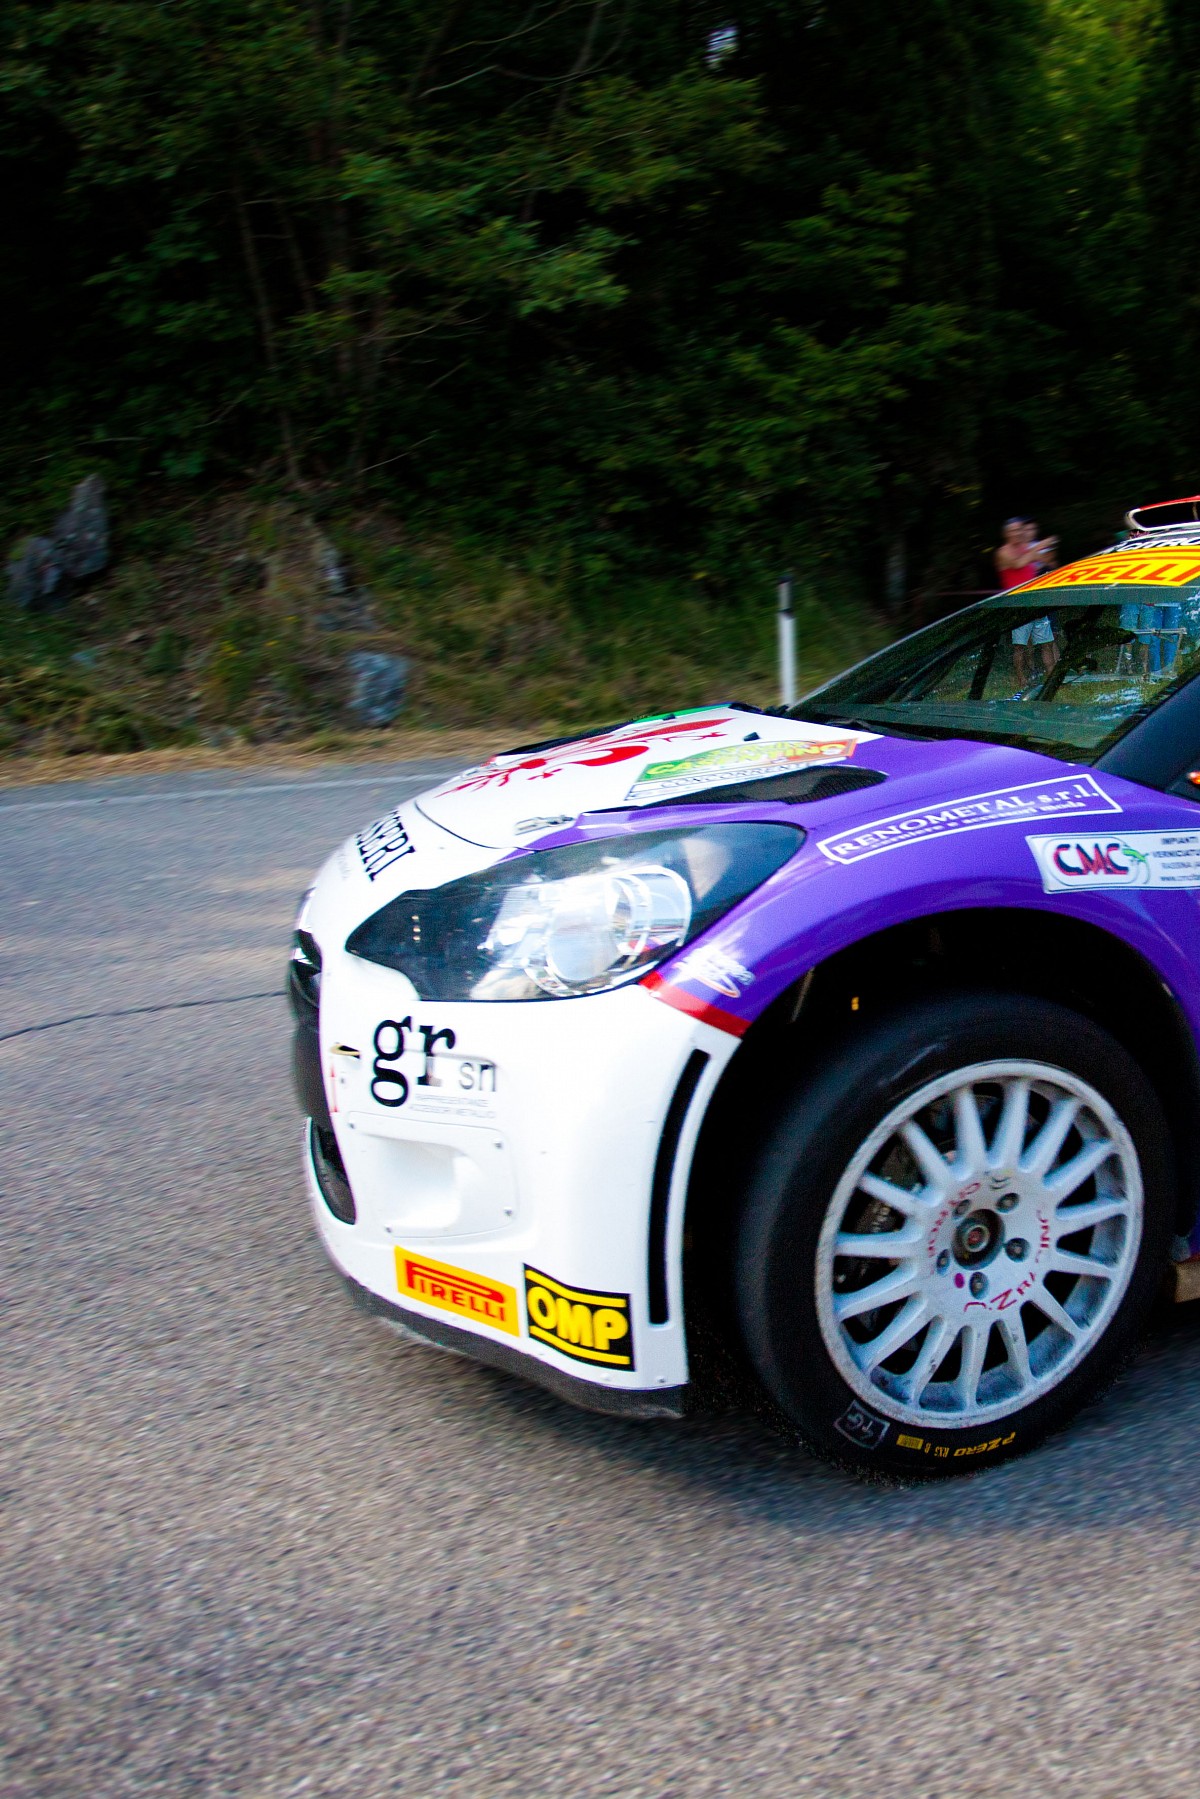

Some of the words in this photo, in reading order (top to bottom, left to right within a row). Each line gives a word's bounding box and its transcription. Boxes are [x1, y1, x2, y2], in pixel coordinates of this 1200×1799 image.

[832, 795, 1035, 855] RENOMETAL
[1053, 843, 1129, 876] CMC
[371, 1016, 456, 1107] gr
[404, 1259, 507, 1322] PIRELLI
[526, 1285, 629, 1351] OMP
